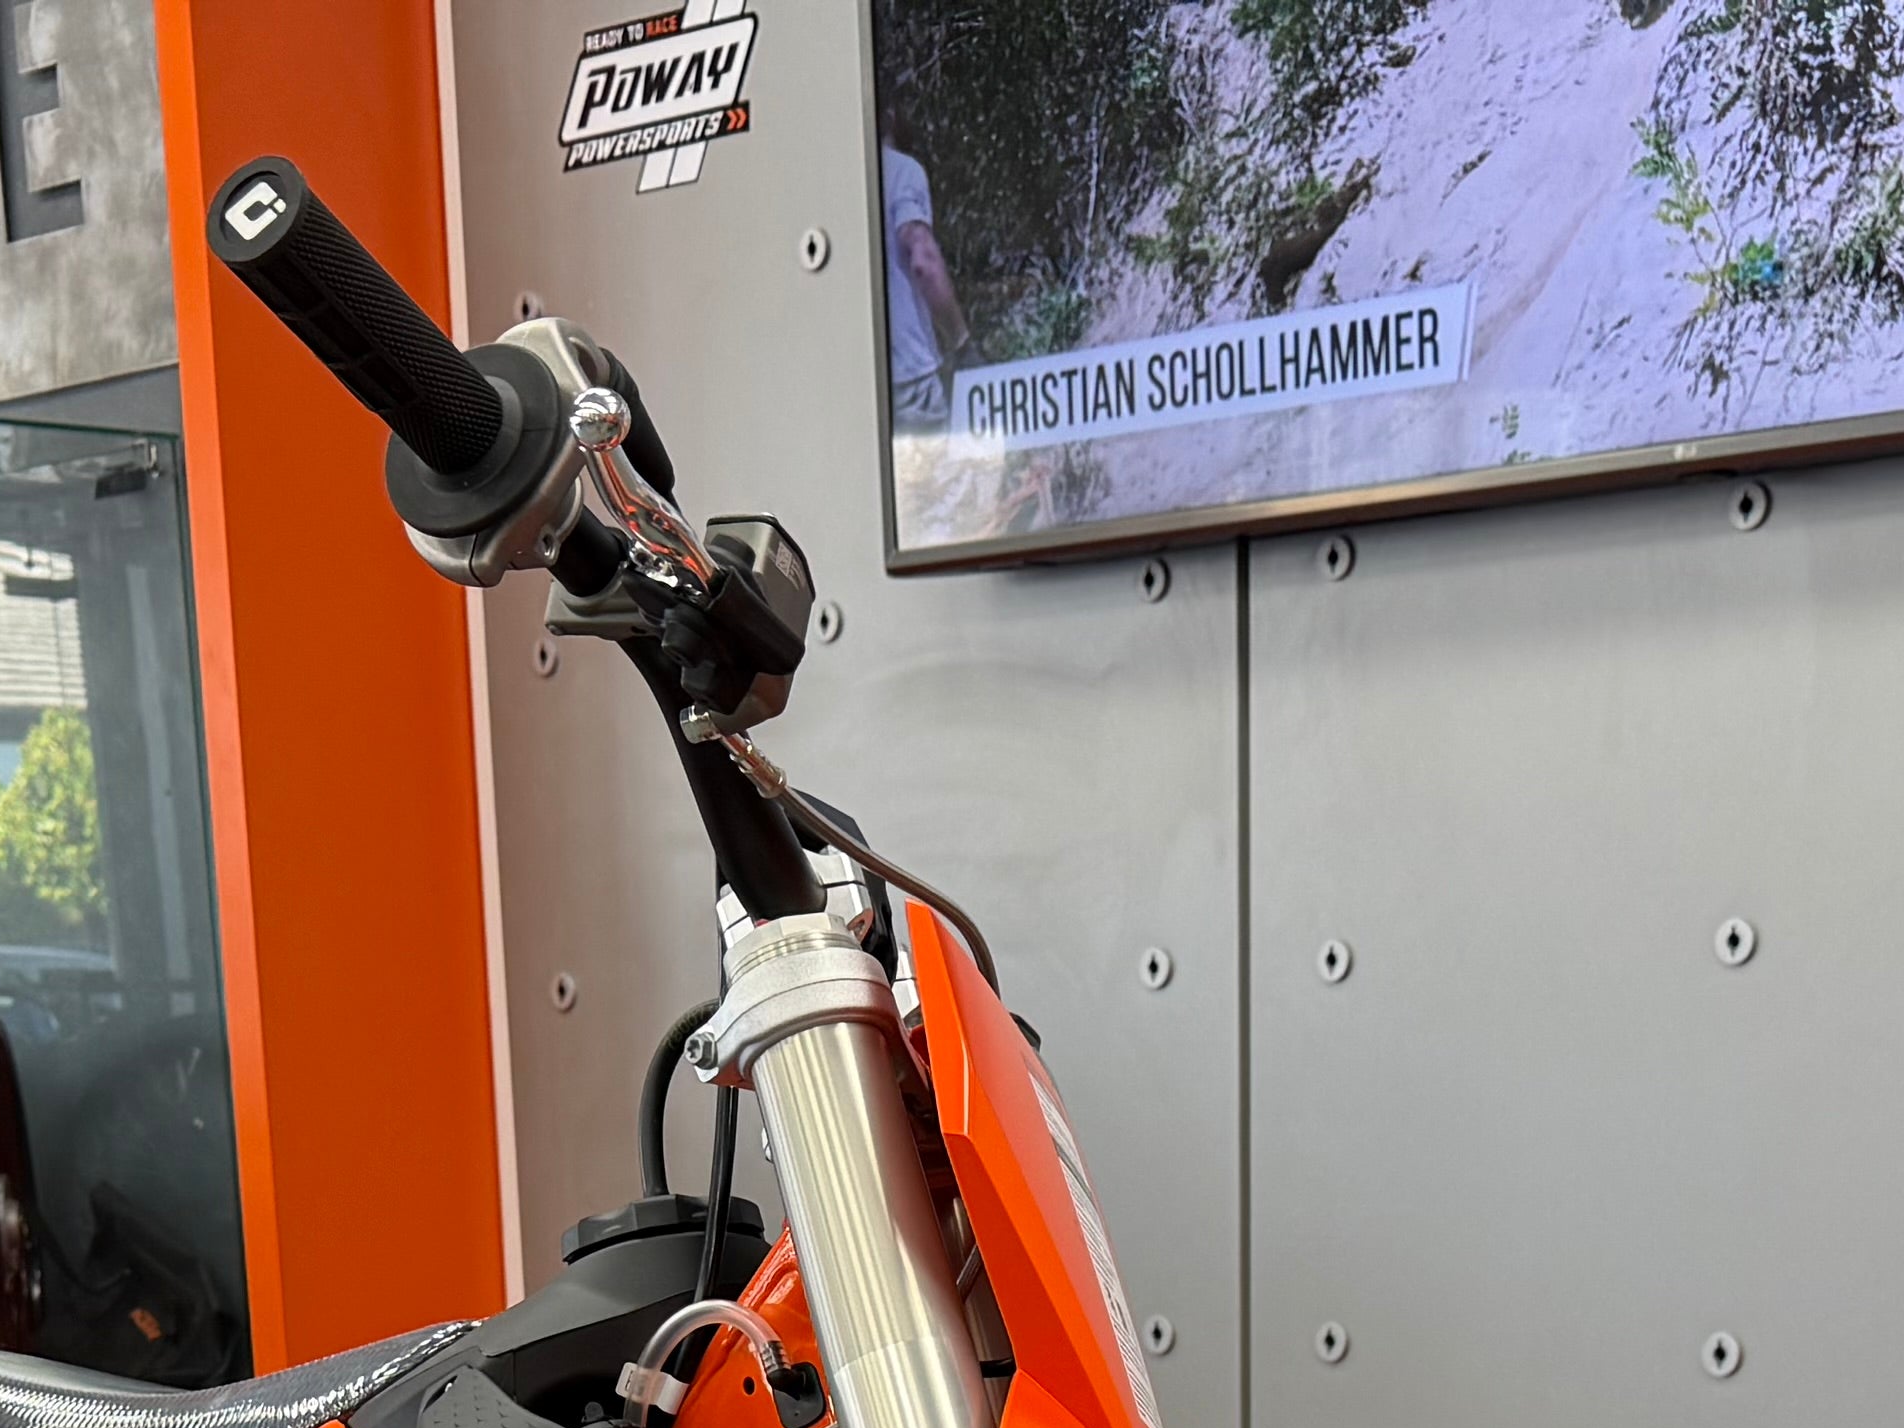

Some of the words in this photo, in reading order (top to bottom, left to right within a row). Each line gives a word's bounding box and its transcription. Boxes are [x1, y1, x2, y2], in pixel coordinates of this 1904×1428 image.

[586, 26, 624, 53] READY
[627, 23, 645, 42] TO
[645, 14, 679, 39] RACE
[567, 109, 726, 168] POWERSPORTS
[967, 357, 1136, 440] CHRISTIAN
[1146, 306, 1441, 413] SCHOLLHAMMER
